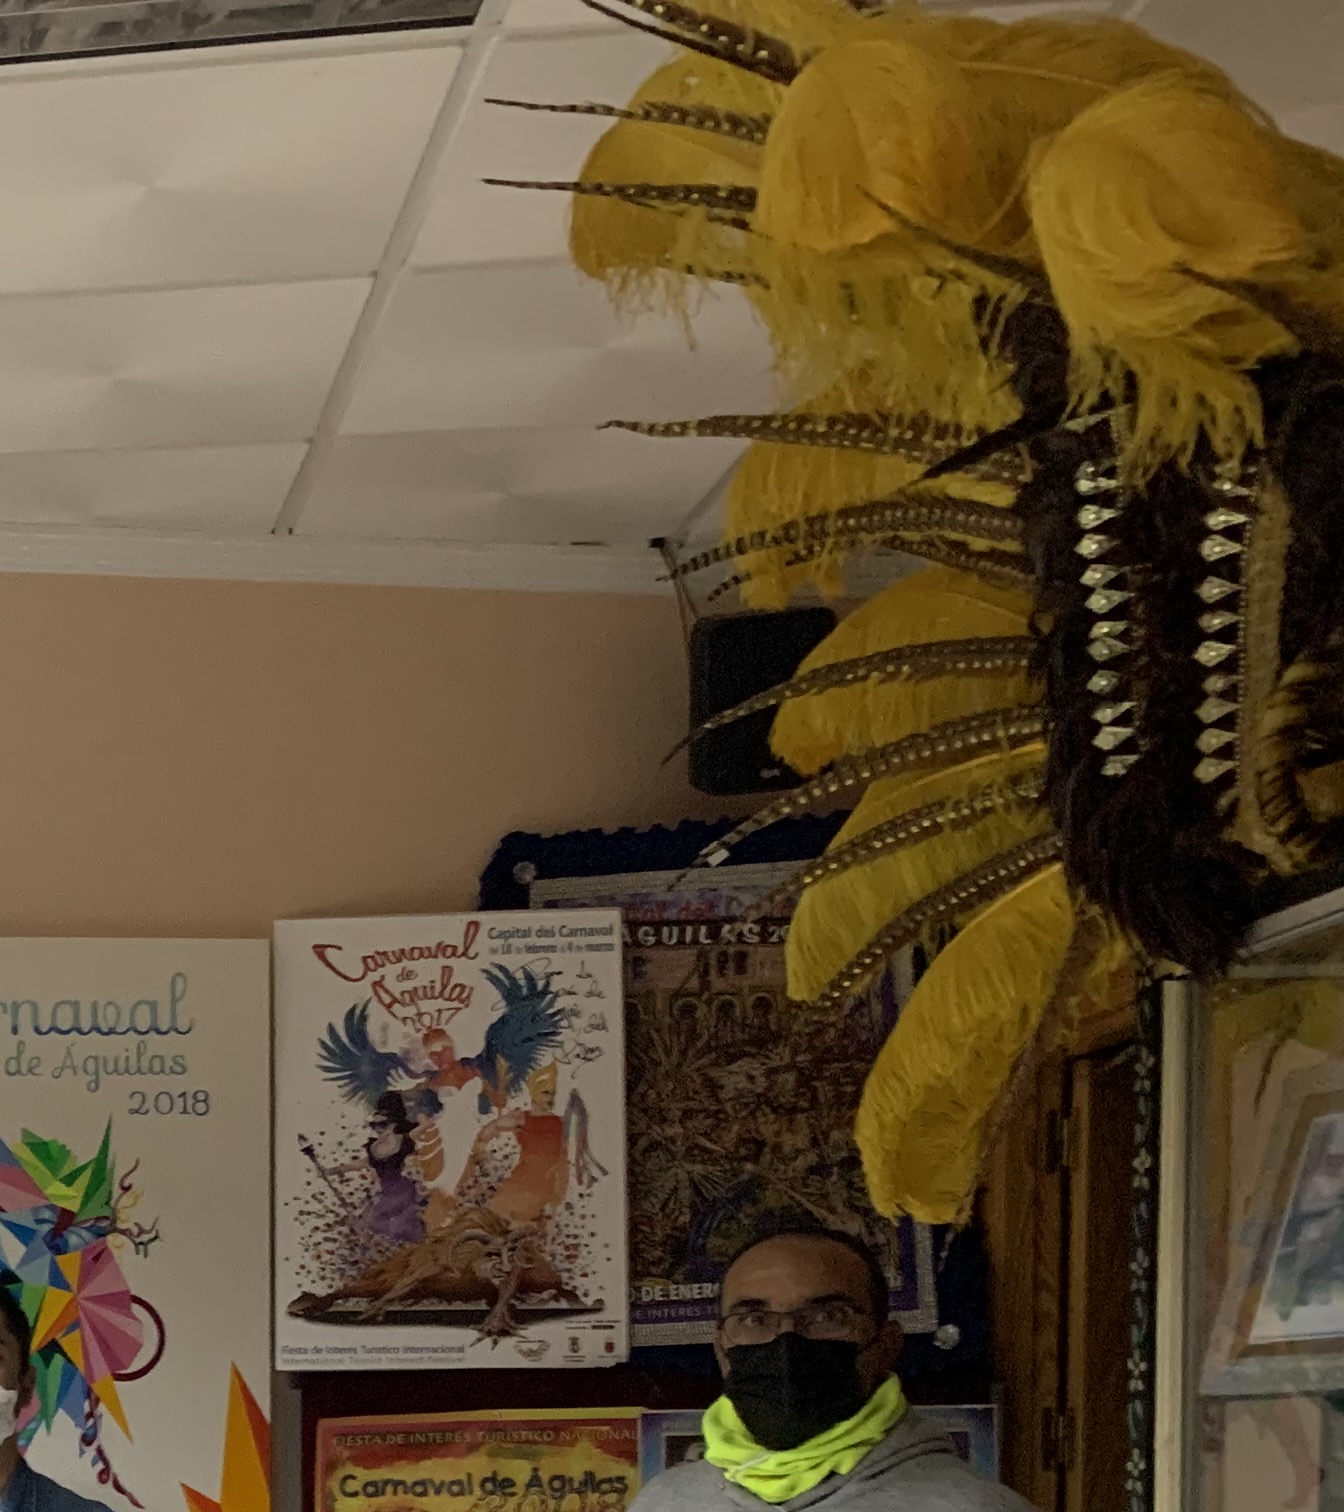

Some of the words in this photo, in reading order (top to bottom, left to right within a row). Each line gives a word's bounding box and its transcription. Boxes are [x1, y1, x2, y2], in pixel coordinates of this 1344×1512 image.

[487, 926, 531, 943] Capital
[535, 925, 556, 938] del
[559, 923, 614, 938] Carnaval
[312, 920, 481, 982] Carnaval
[396, 966, 418, 982] de
[402, 1006, 464, 1033] 2017
[4, 1040, 42, 1077] de
[51, 1040, 188, 1093] Águilas
[127, 1090, 211, 1117] 2018
[642, 1286, 664, 1301] DE
[387, 1433, 407, 1446] DE
[339, 1471, 474, 1498] Carnaval
[479, 1470, 517, 1497] de
